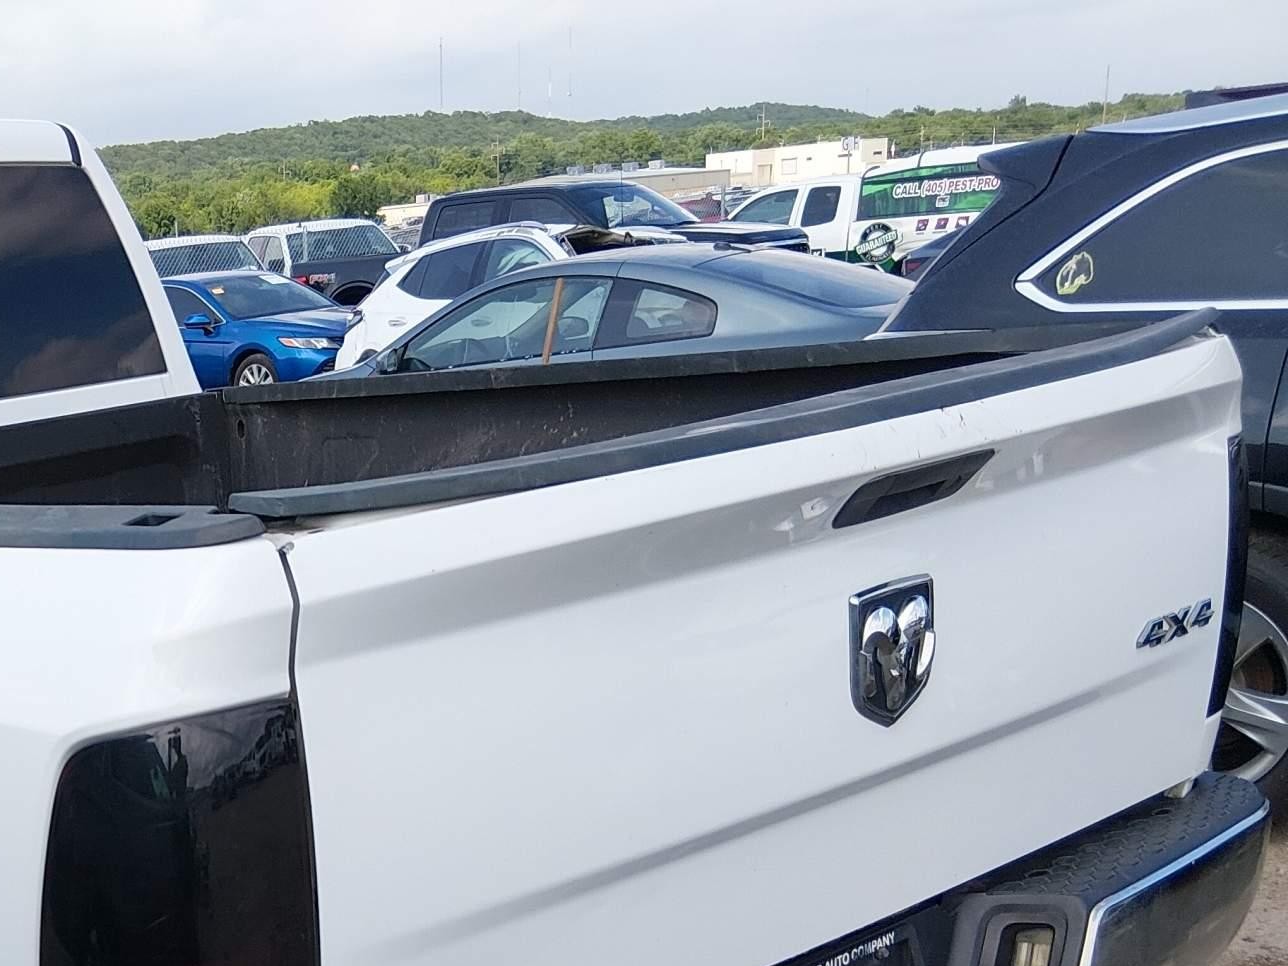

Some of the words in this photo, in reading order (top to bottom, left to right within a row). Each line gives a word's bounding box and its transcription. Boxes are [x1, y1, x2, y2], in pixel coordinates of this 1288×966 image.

[893, 183, 920, 198] CALL
[921, 179, 947, 197] (405)
[856, 231, 897, 254] GUARANTEED
[1136, 598, 1215, 649] 4X4
[851, 931, 896, 961] COMPANY
